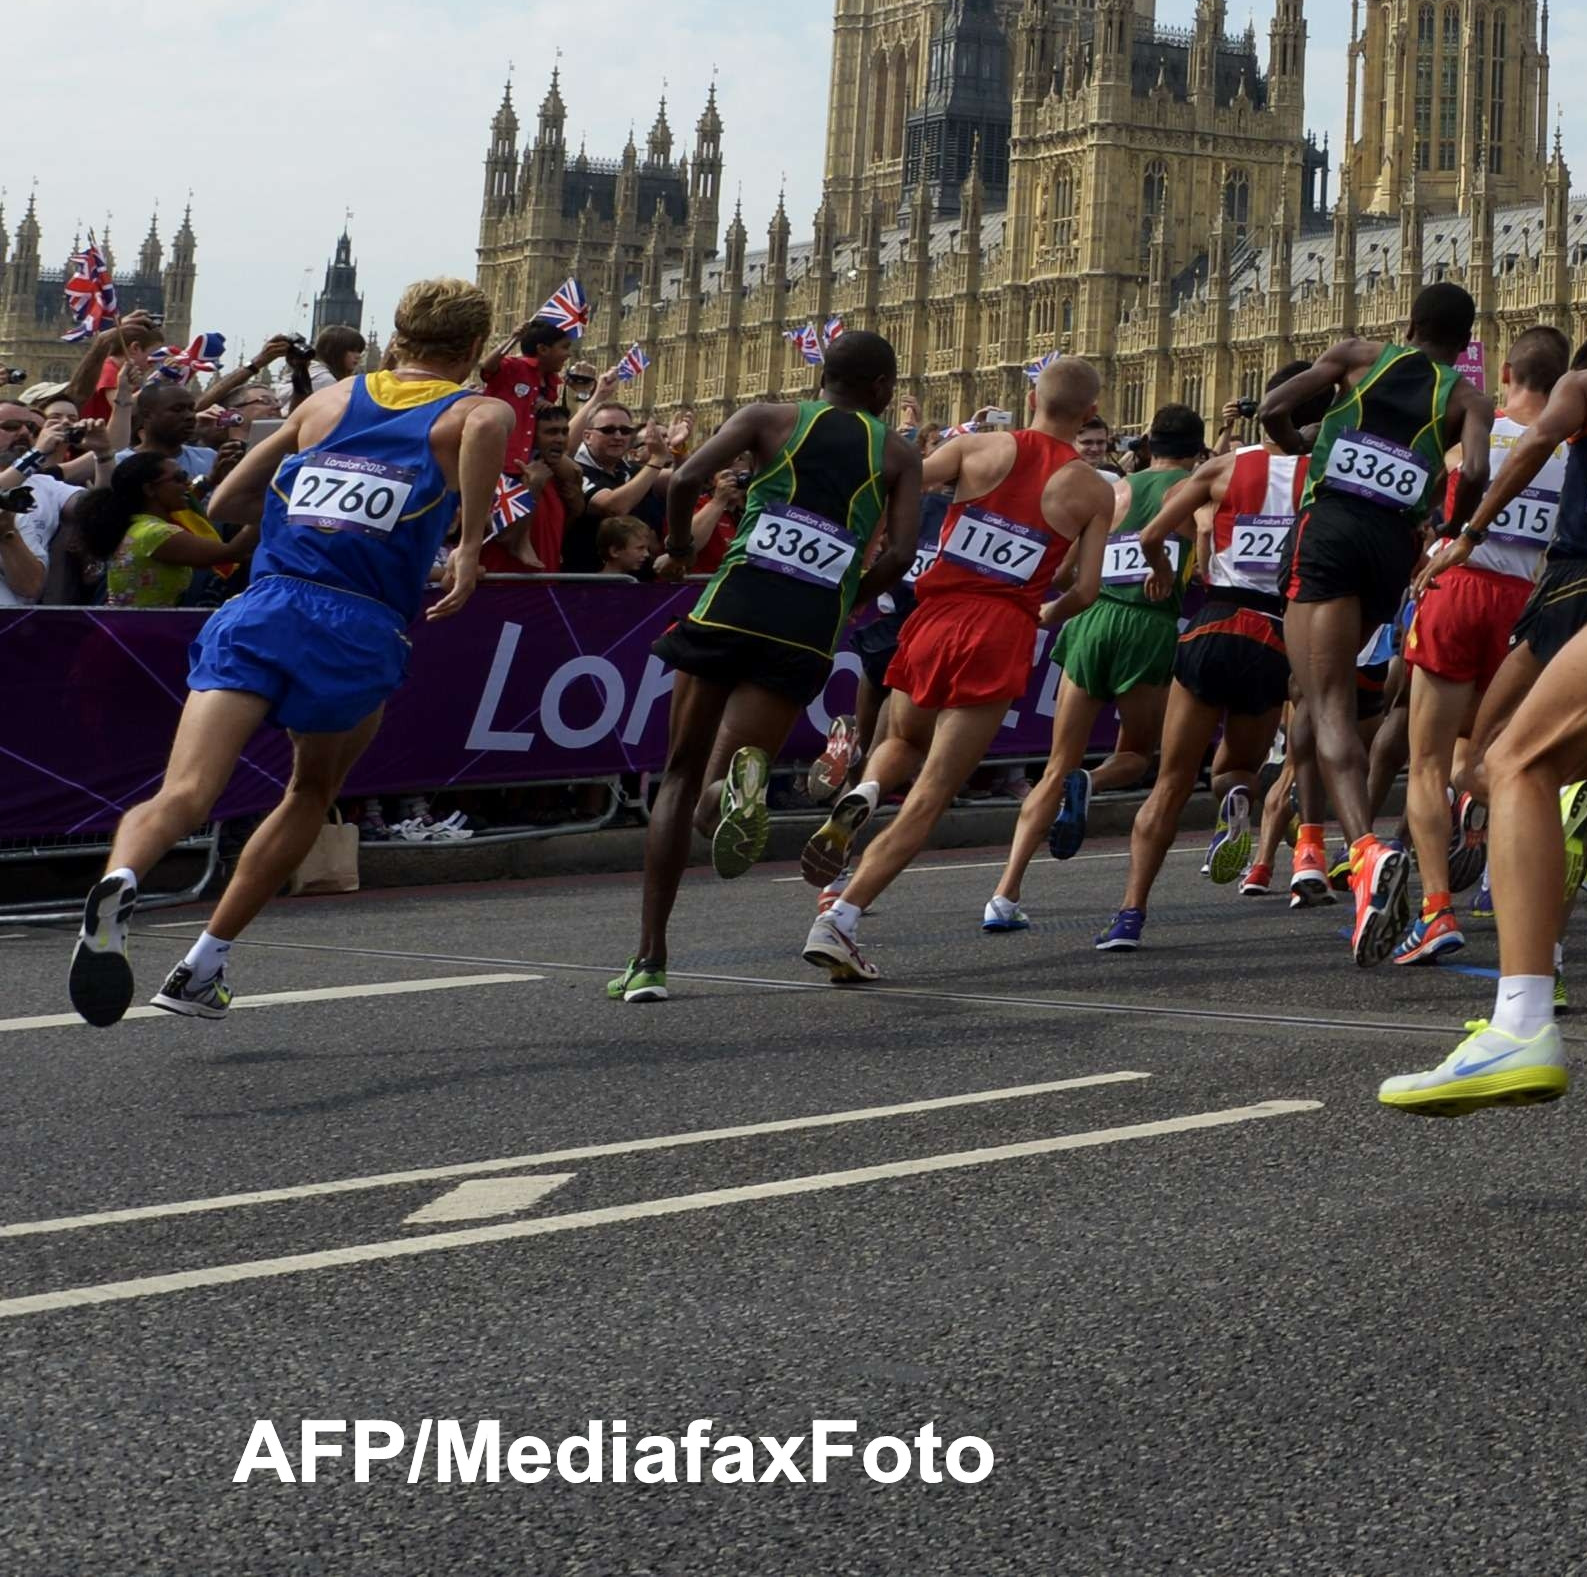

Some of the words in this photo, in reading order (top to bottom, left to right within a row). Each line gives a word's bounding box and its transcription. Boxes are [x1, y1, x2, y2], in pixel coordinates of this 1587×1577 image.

[324, 456, 361, 471] London
[360, 461, 387, 475] 2012
[1361, 436, 1392, 453] London
[1392, 445, 1413, 460] 2012
[1336, 447, 1418, 496] 3368
[295, 475, 396, 520] 2760
[786, 509, 819, 526] London
[818, 520, 840, 535] 2012
[756, 522, 847, 570] 3367
[960, 525, 1038, 569] 1167
